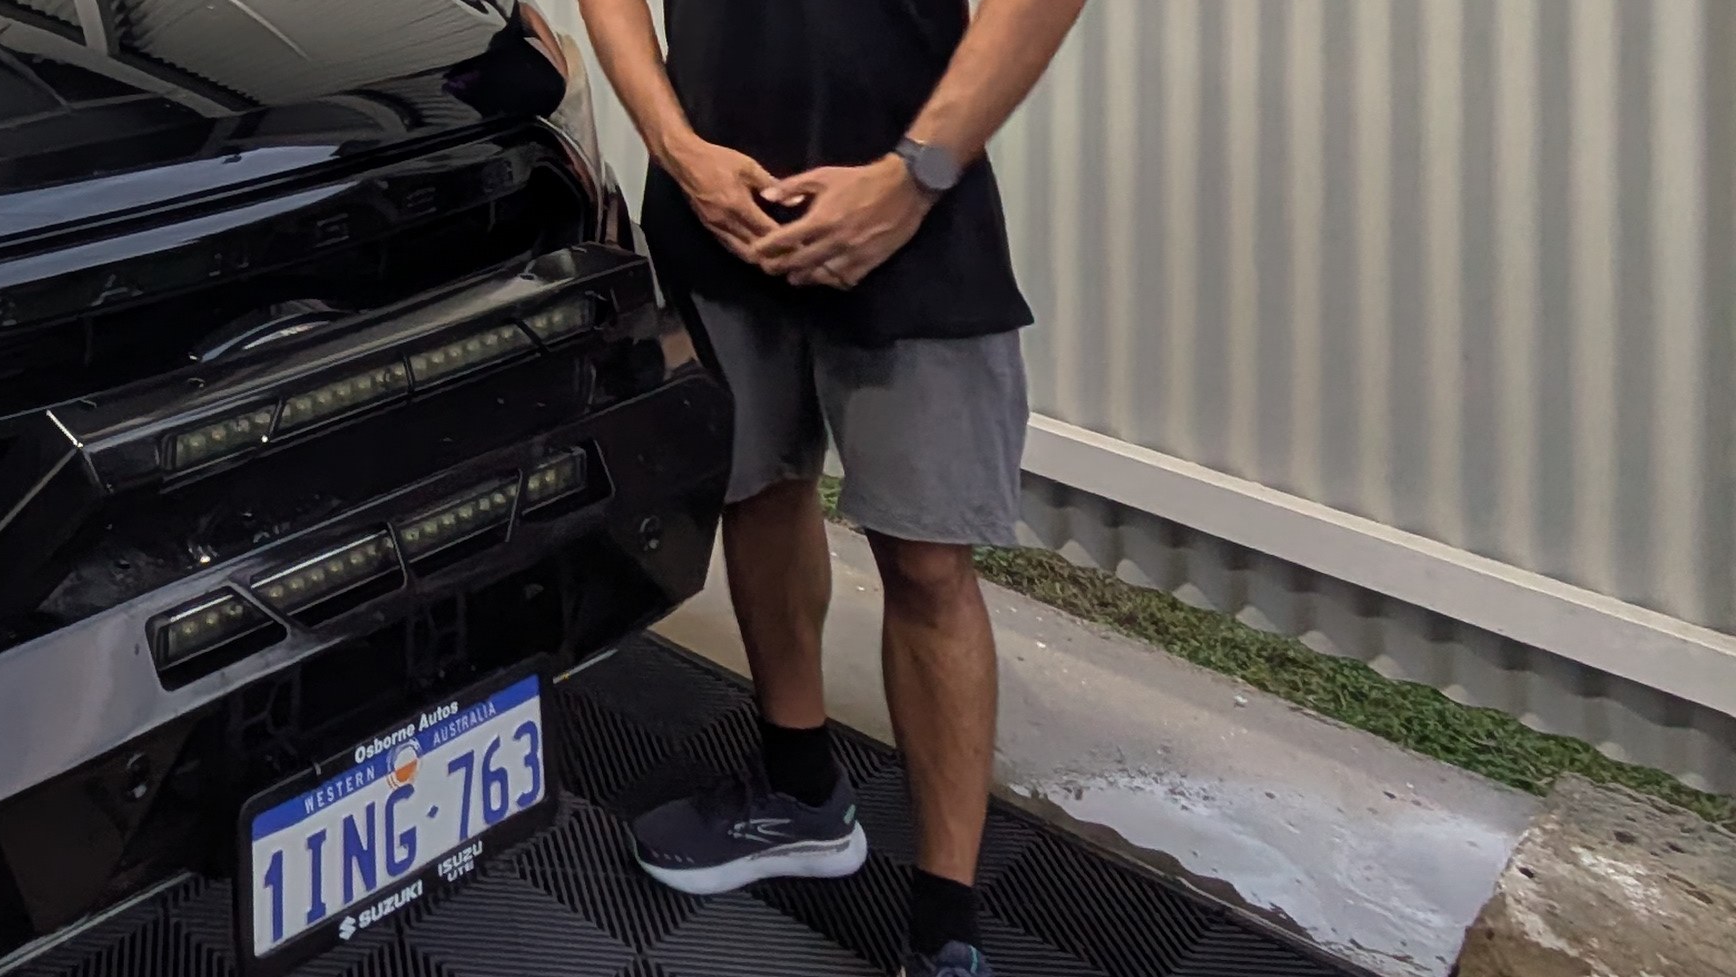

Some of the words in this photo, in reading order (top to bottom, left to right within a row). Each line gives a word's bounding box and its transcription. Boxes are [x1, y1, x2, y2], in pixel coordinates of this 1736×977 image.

[304, 765, 375, 814] WESTERN
[433, 701, 496, 746] AUSTRALIA
[355, 723, 415, 764] Osborne
[419, 701, 459, 731] Autos
[437, 840, 483, 876] ISUZU
[358, 879, 423, 928] SUZUKI
